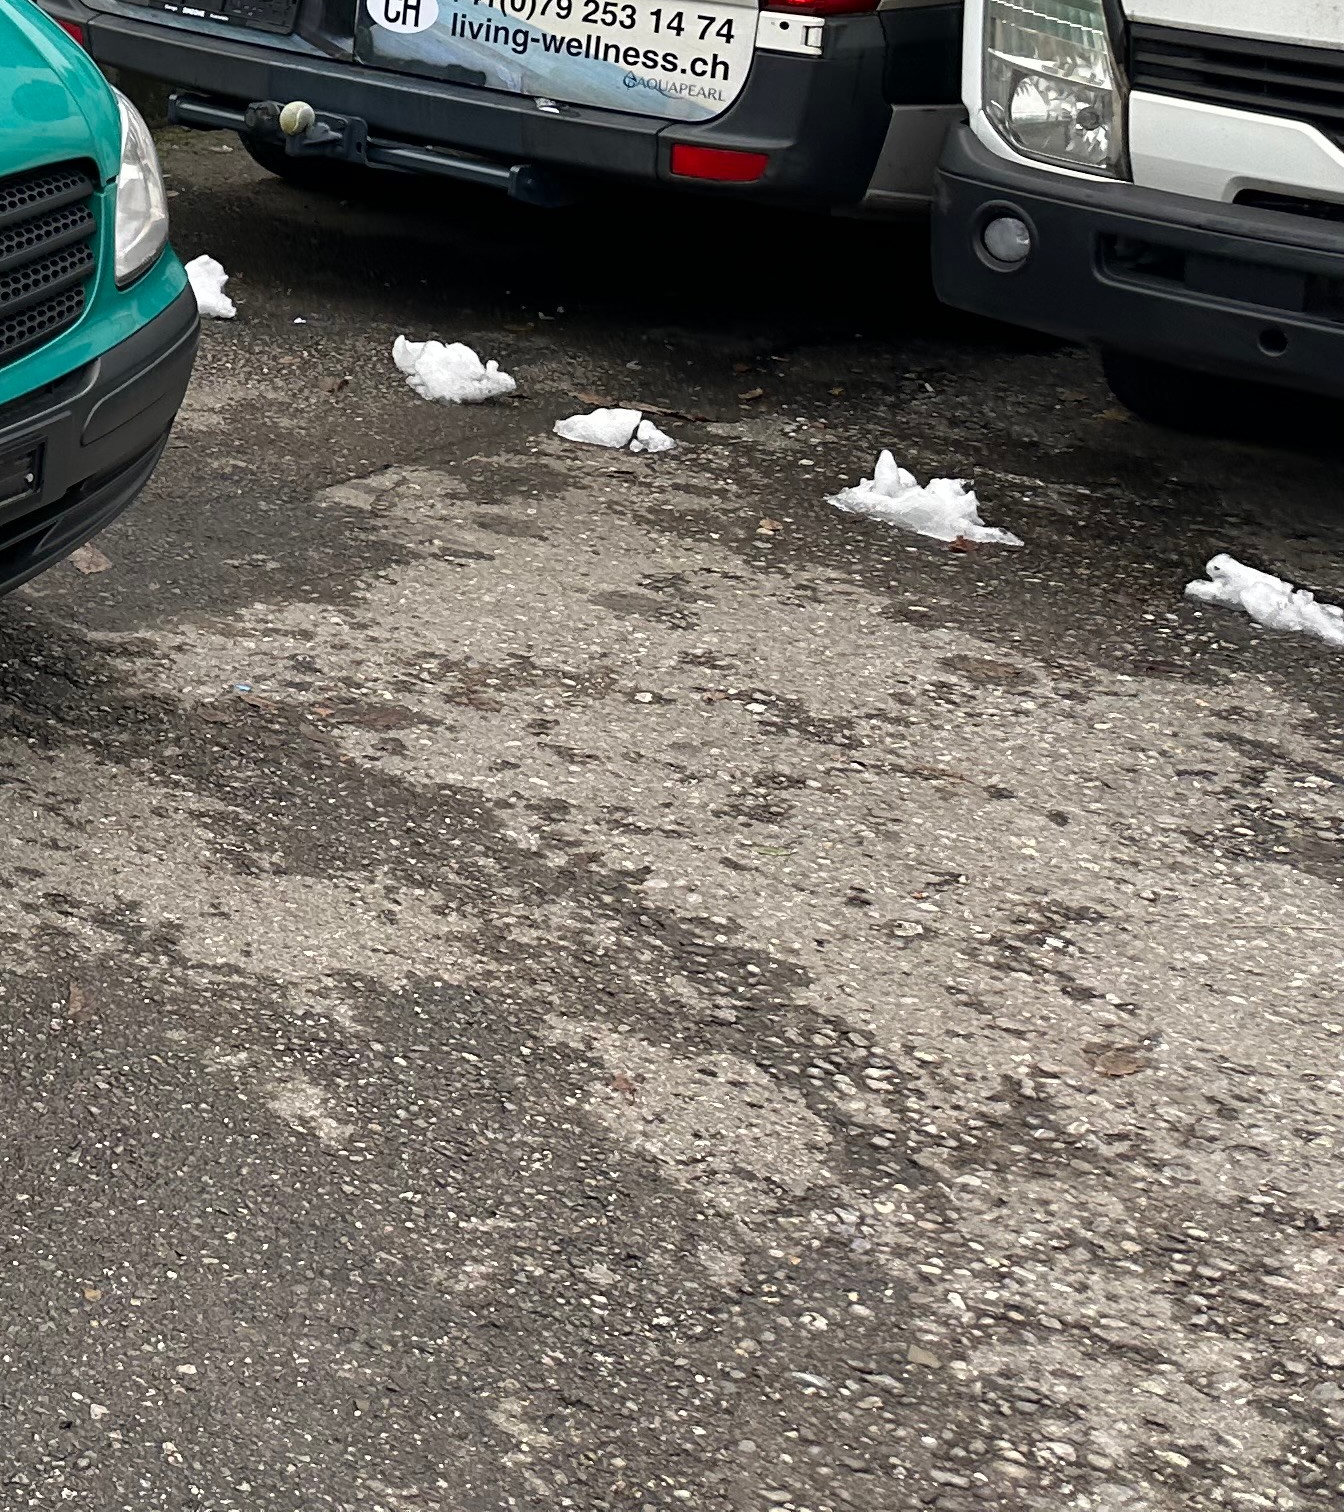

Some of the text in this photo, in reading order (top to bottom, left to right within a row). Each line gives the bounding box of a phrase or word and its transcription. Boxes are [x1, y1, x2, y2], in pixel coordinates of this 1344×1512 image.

[650, 8, 686, 37] 14
[697, 14, 735, 44] 74
[450, 12, 730, 80] living-wellness.ch
[637, 76, 726, 102] AQUAPEARL
